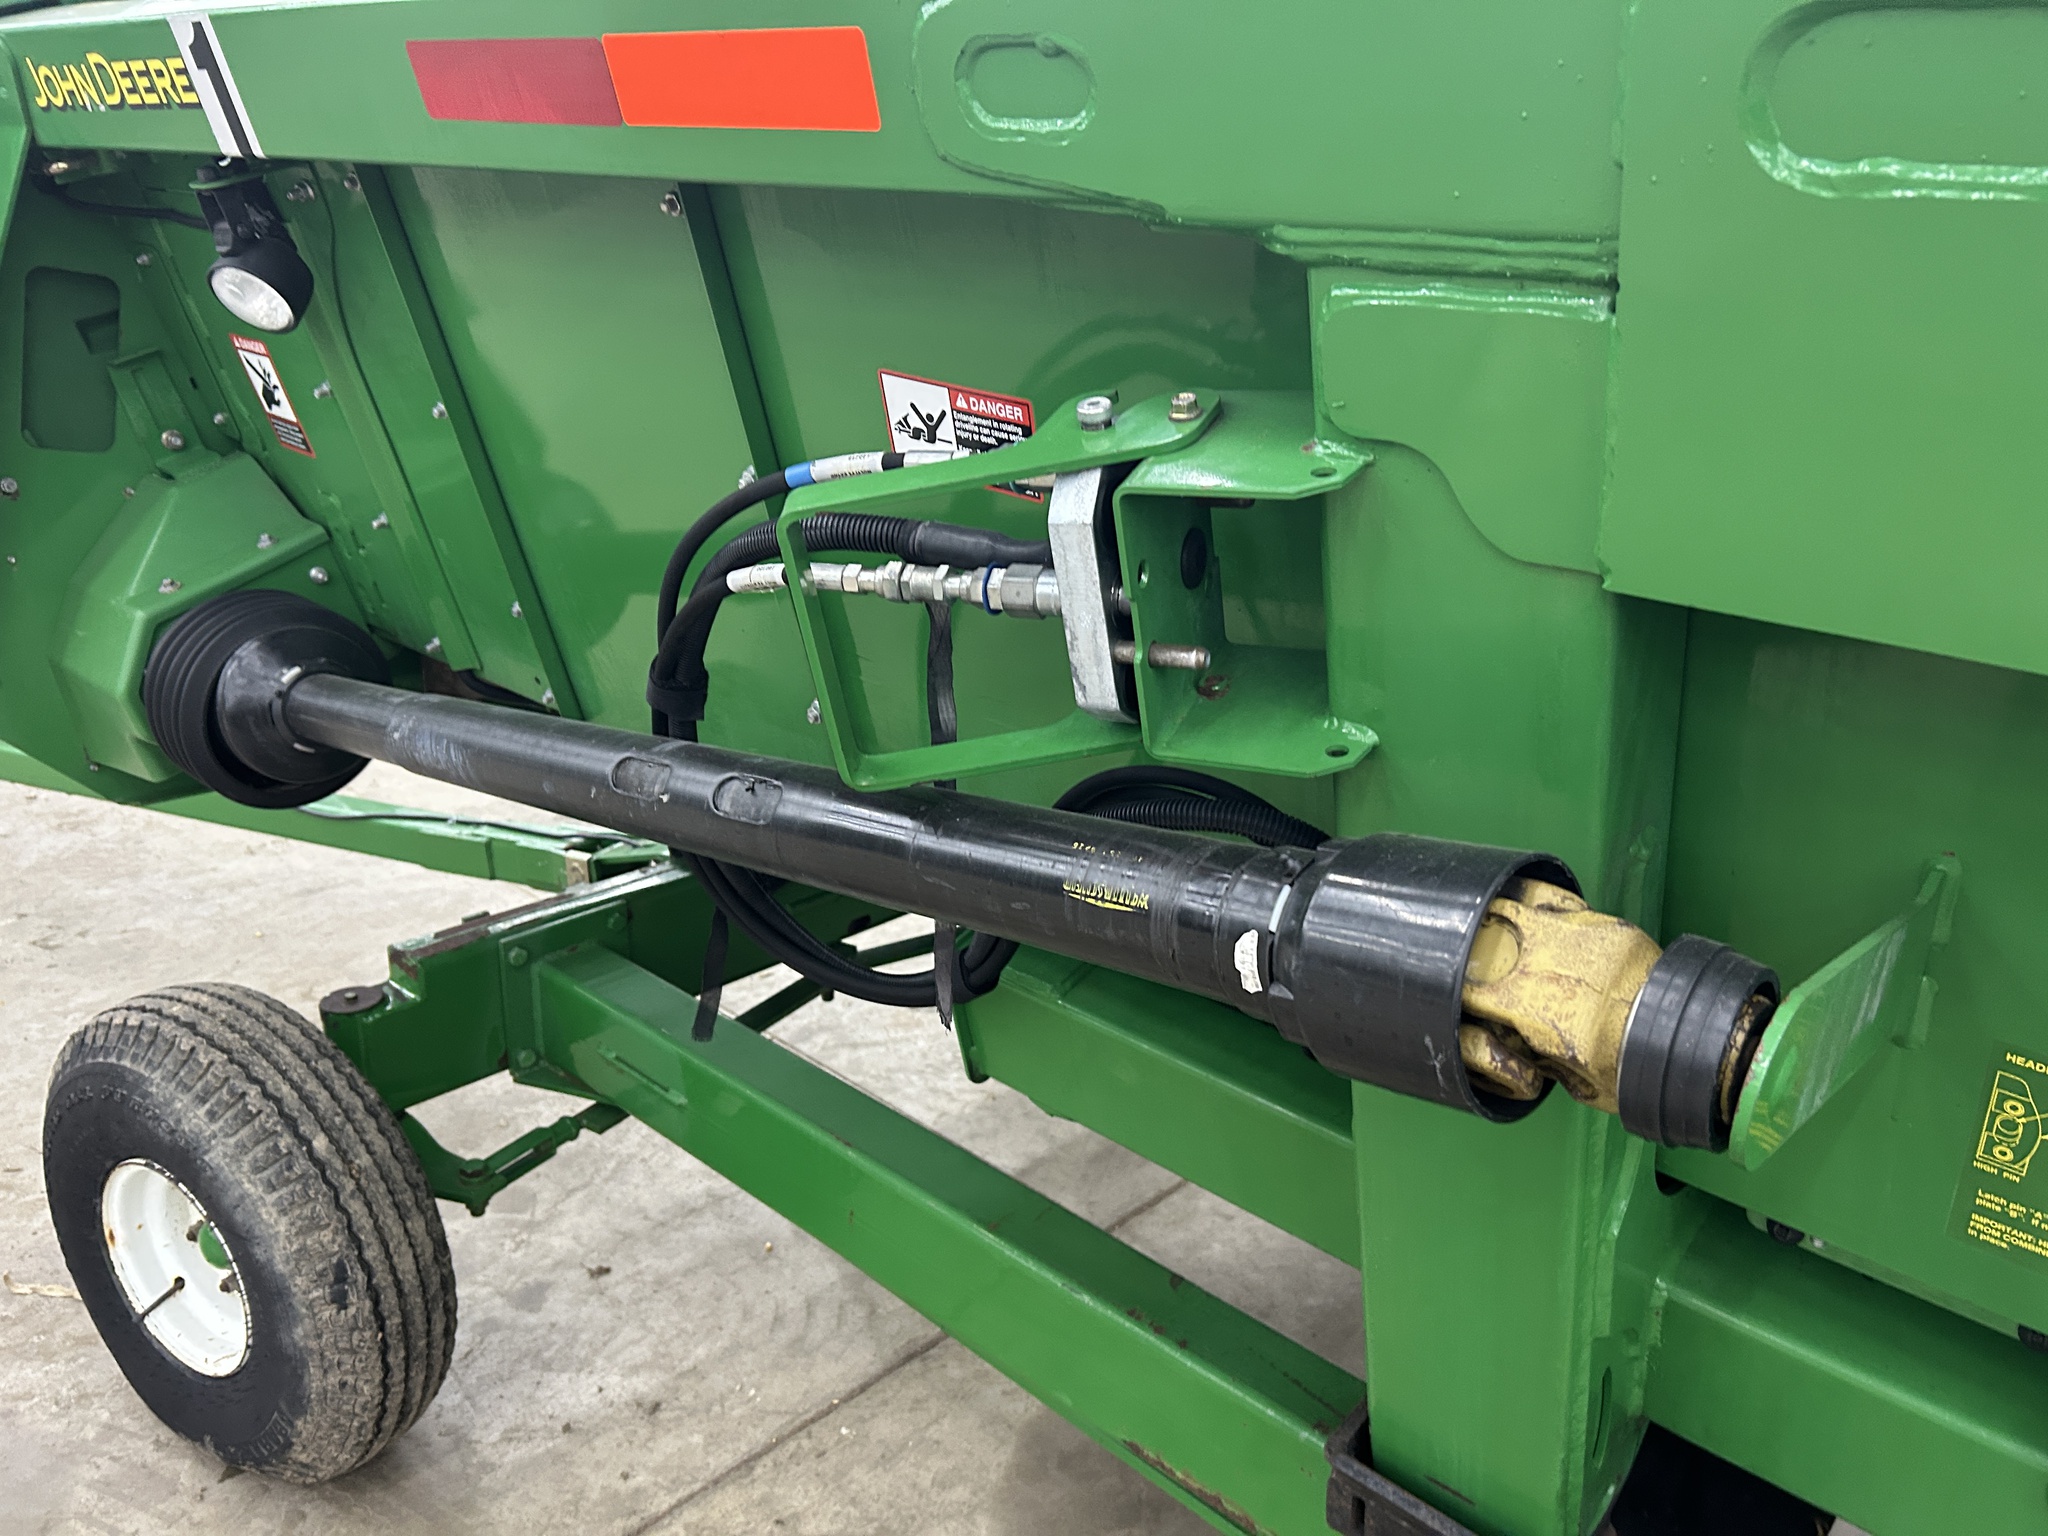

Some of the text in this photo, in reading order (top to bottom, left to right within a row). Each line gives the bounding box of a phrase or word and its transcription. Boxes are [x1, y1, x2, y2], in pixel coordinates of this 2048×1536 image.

[25, 52, 202, 109] JOHN DEERE
[188, 21, 254, 157] 1
[969, 397, 1024, 421] DANGER
[979, 426, 991, 436] can
[1000, 422, 1023, 435] rotating
[1973, 1160, 2020, 1184] HIGH PIN
[1975, 1197, 2002, 1213] plate
[1978, 1188, 2007, 1207] Latch
[2009, 1202, 2026, 1215] pin
[1967, 1227, 1978, 1238] in
[1969, 1220, 2001, 1238] FROM
[1971, 1212, 2036, 1244] IMPORTANT:
